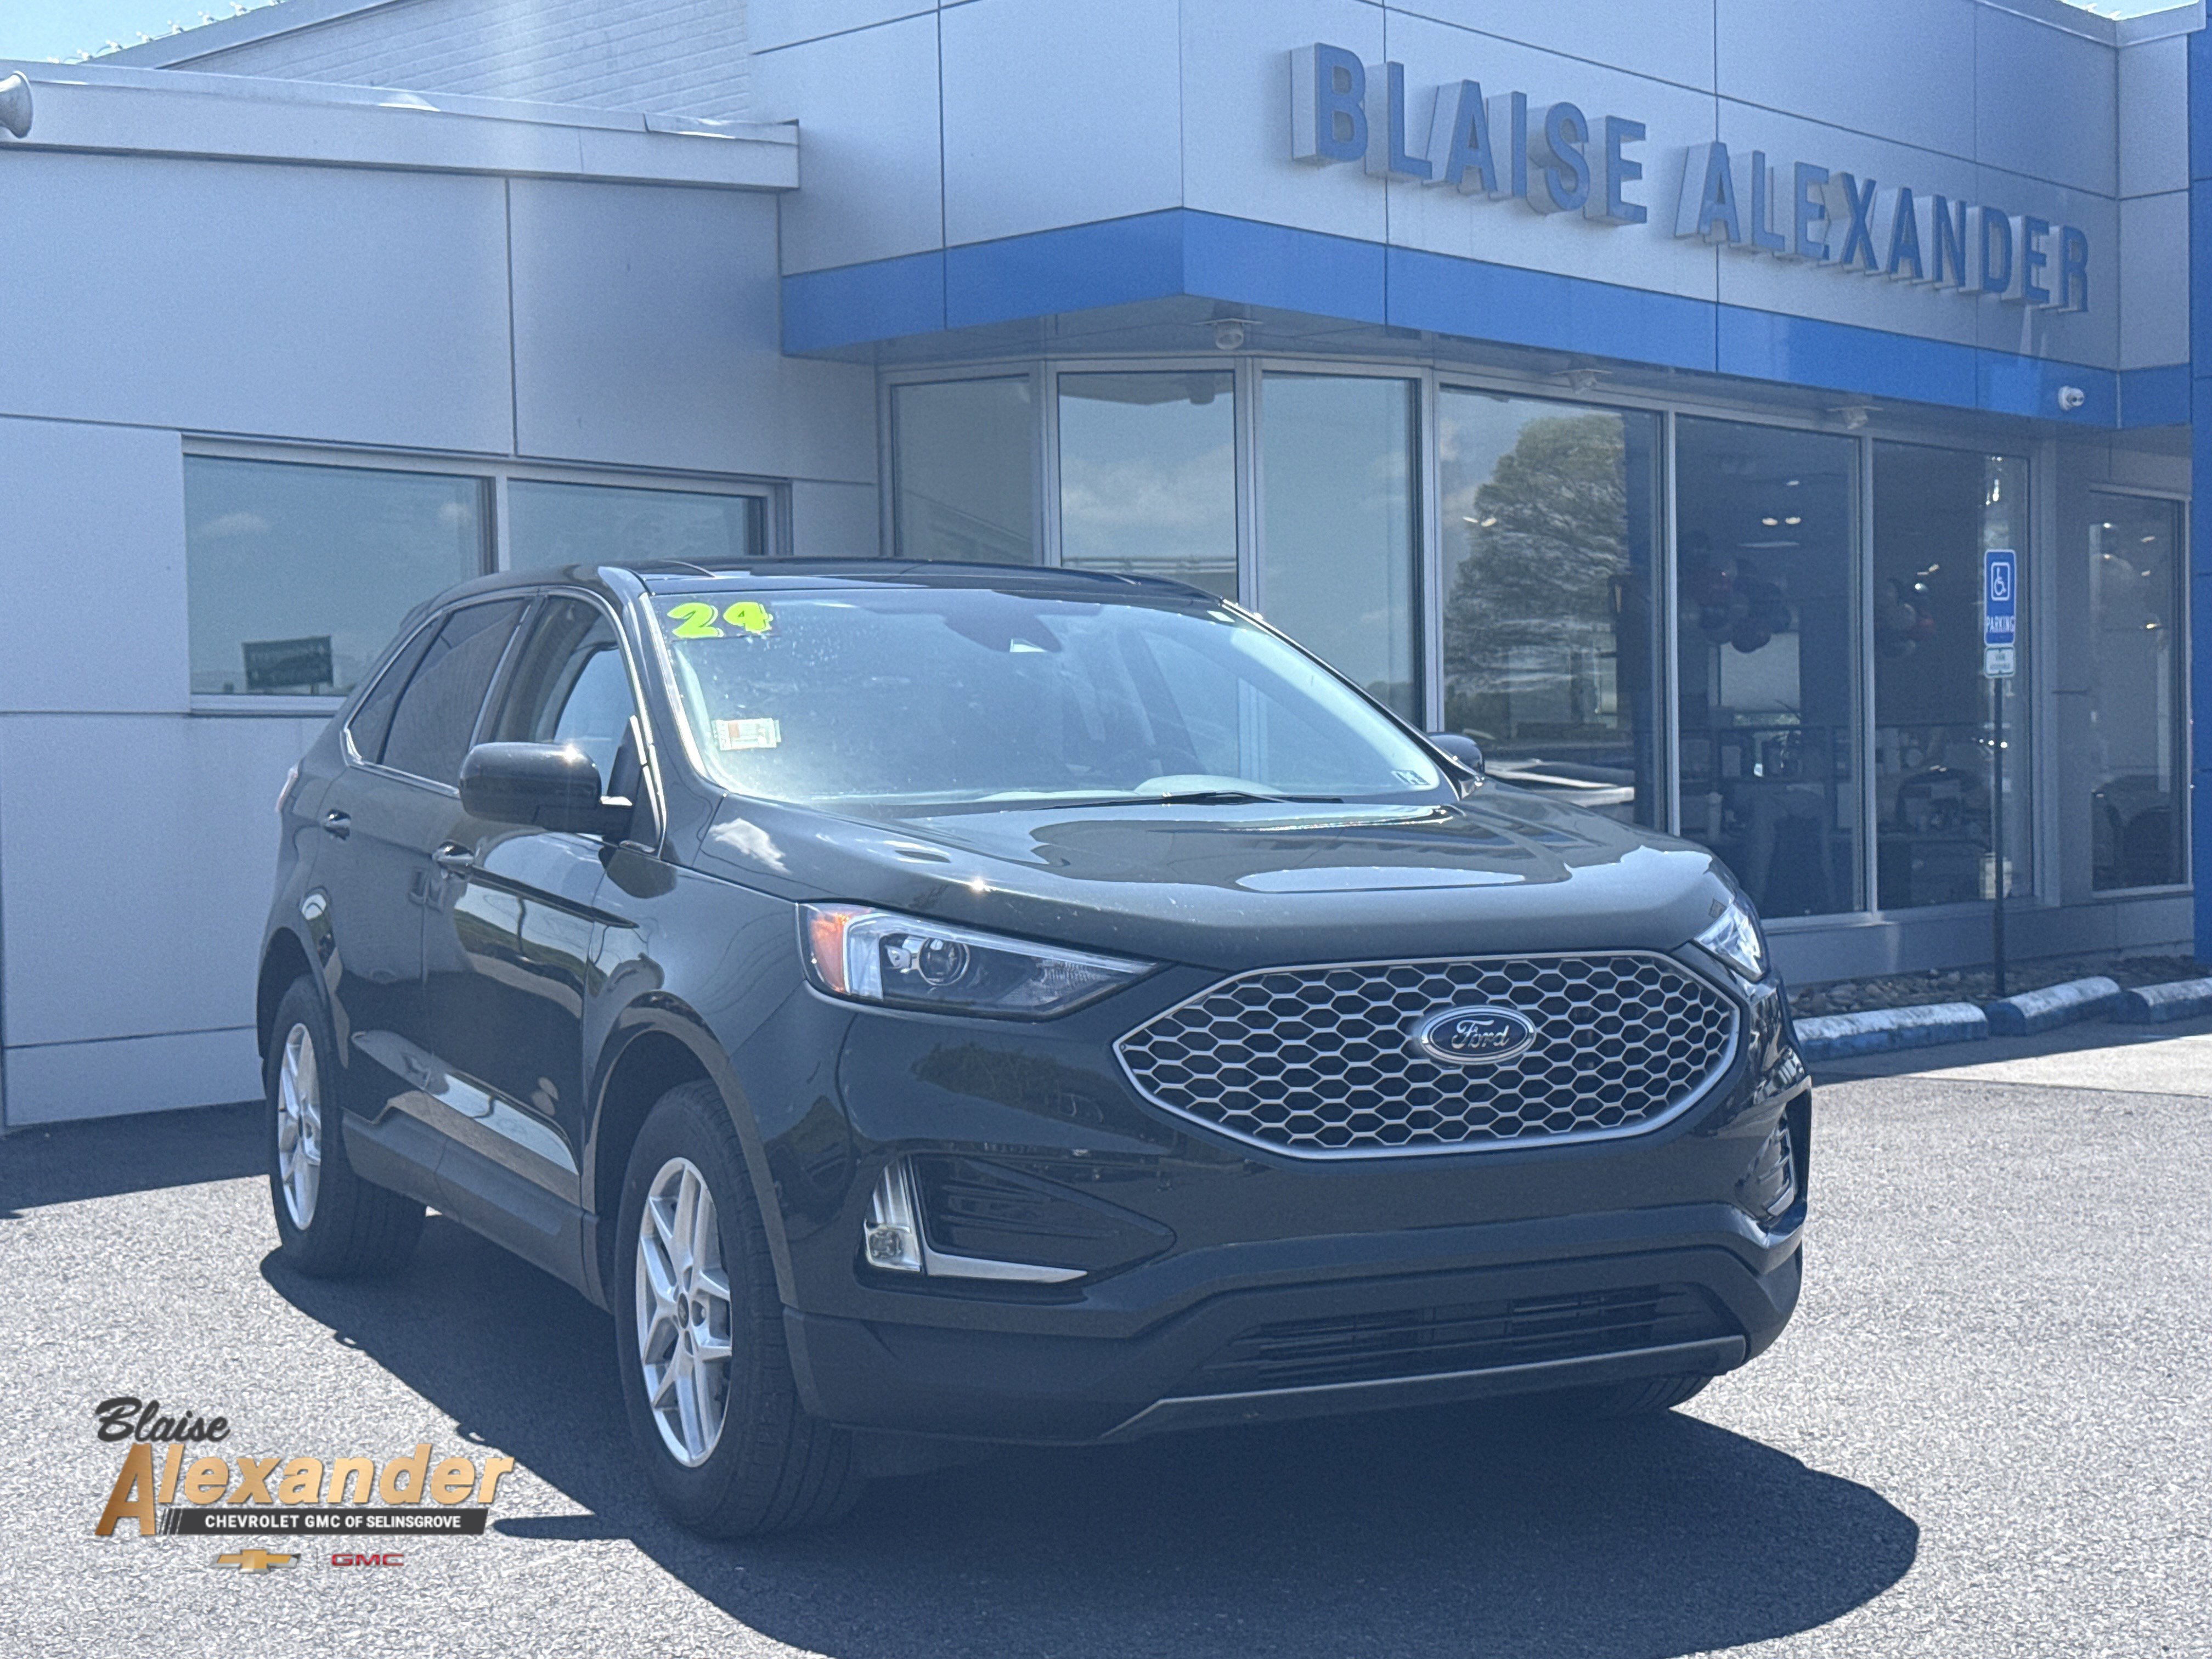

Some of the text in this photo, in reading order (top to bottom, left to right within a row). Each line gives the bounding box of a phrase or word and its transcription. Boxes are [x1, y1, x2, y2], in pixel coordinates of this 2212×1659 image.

[1313, 42, 2089, 313] BLAISE ALEXANDER
[667, 601, 774, 638] 24
[1986, 616, 2015, 633] PARKING
[1451, 1019, 1509, 1049] Ford
